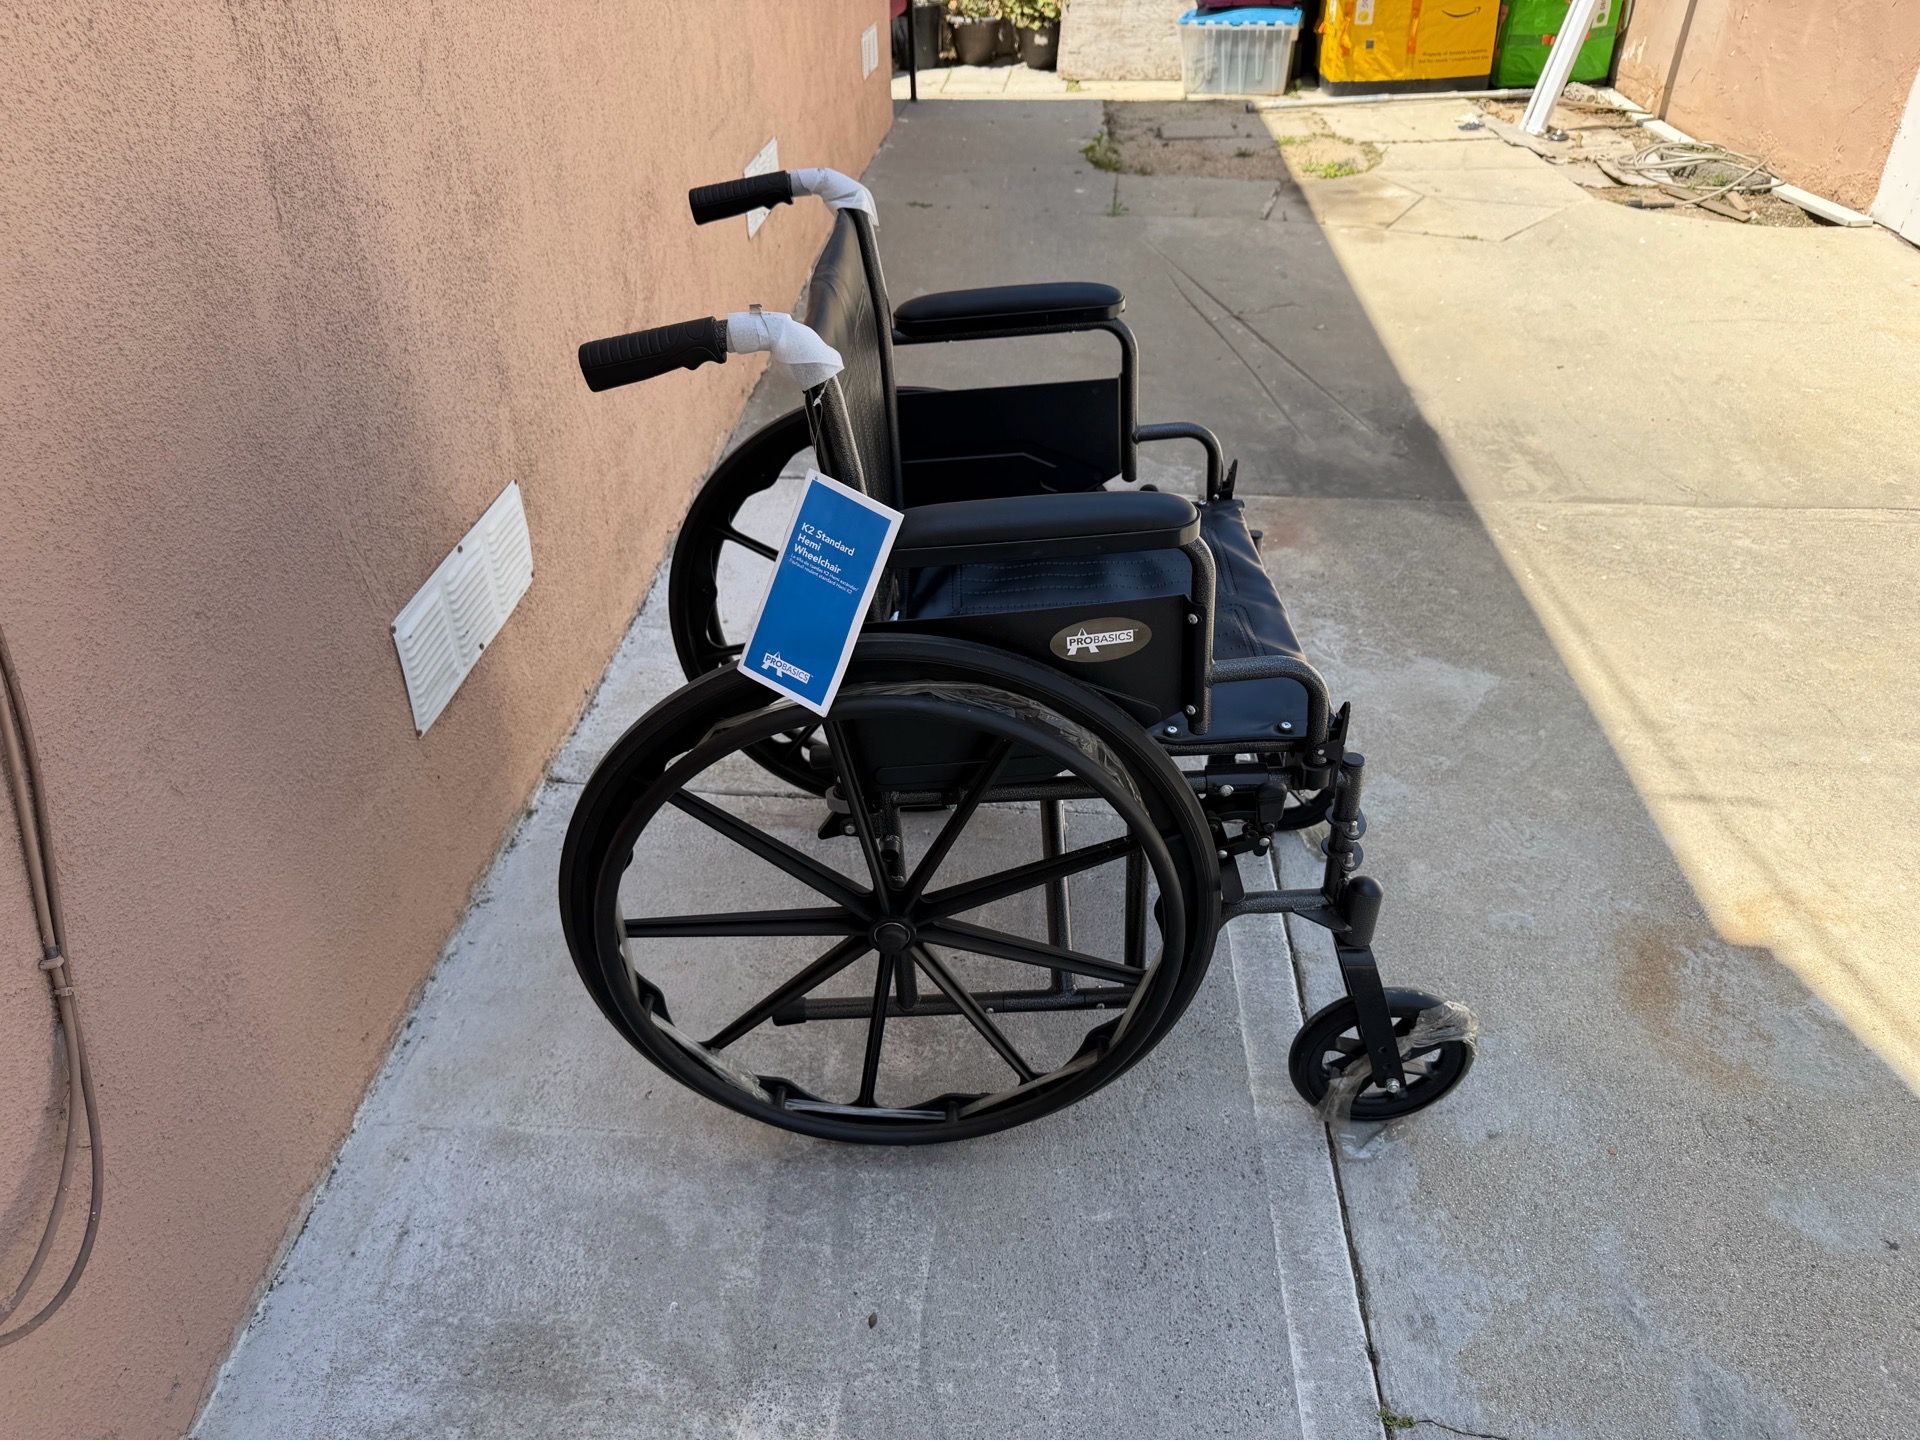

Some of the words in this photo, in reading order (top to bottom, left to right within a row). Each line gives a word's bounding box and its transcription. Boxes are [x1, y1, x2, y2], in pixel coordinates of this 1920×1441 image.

[797, 533, 821, 551] Hemi
[801, 522, 815, 535] K2
[816, 530, 855, 556] Standard
[794, 543, 841, 573] Wheelchair
[1069, 631, 1132, 647] PROBASICS
[765, 655, 809, 682] PROBASICS
